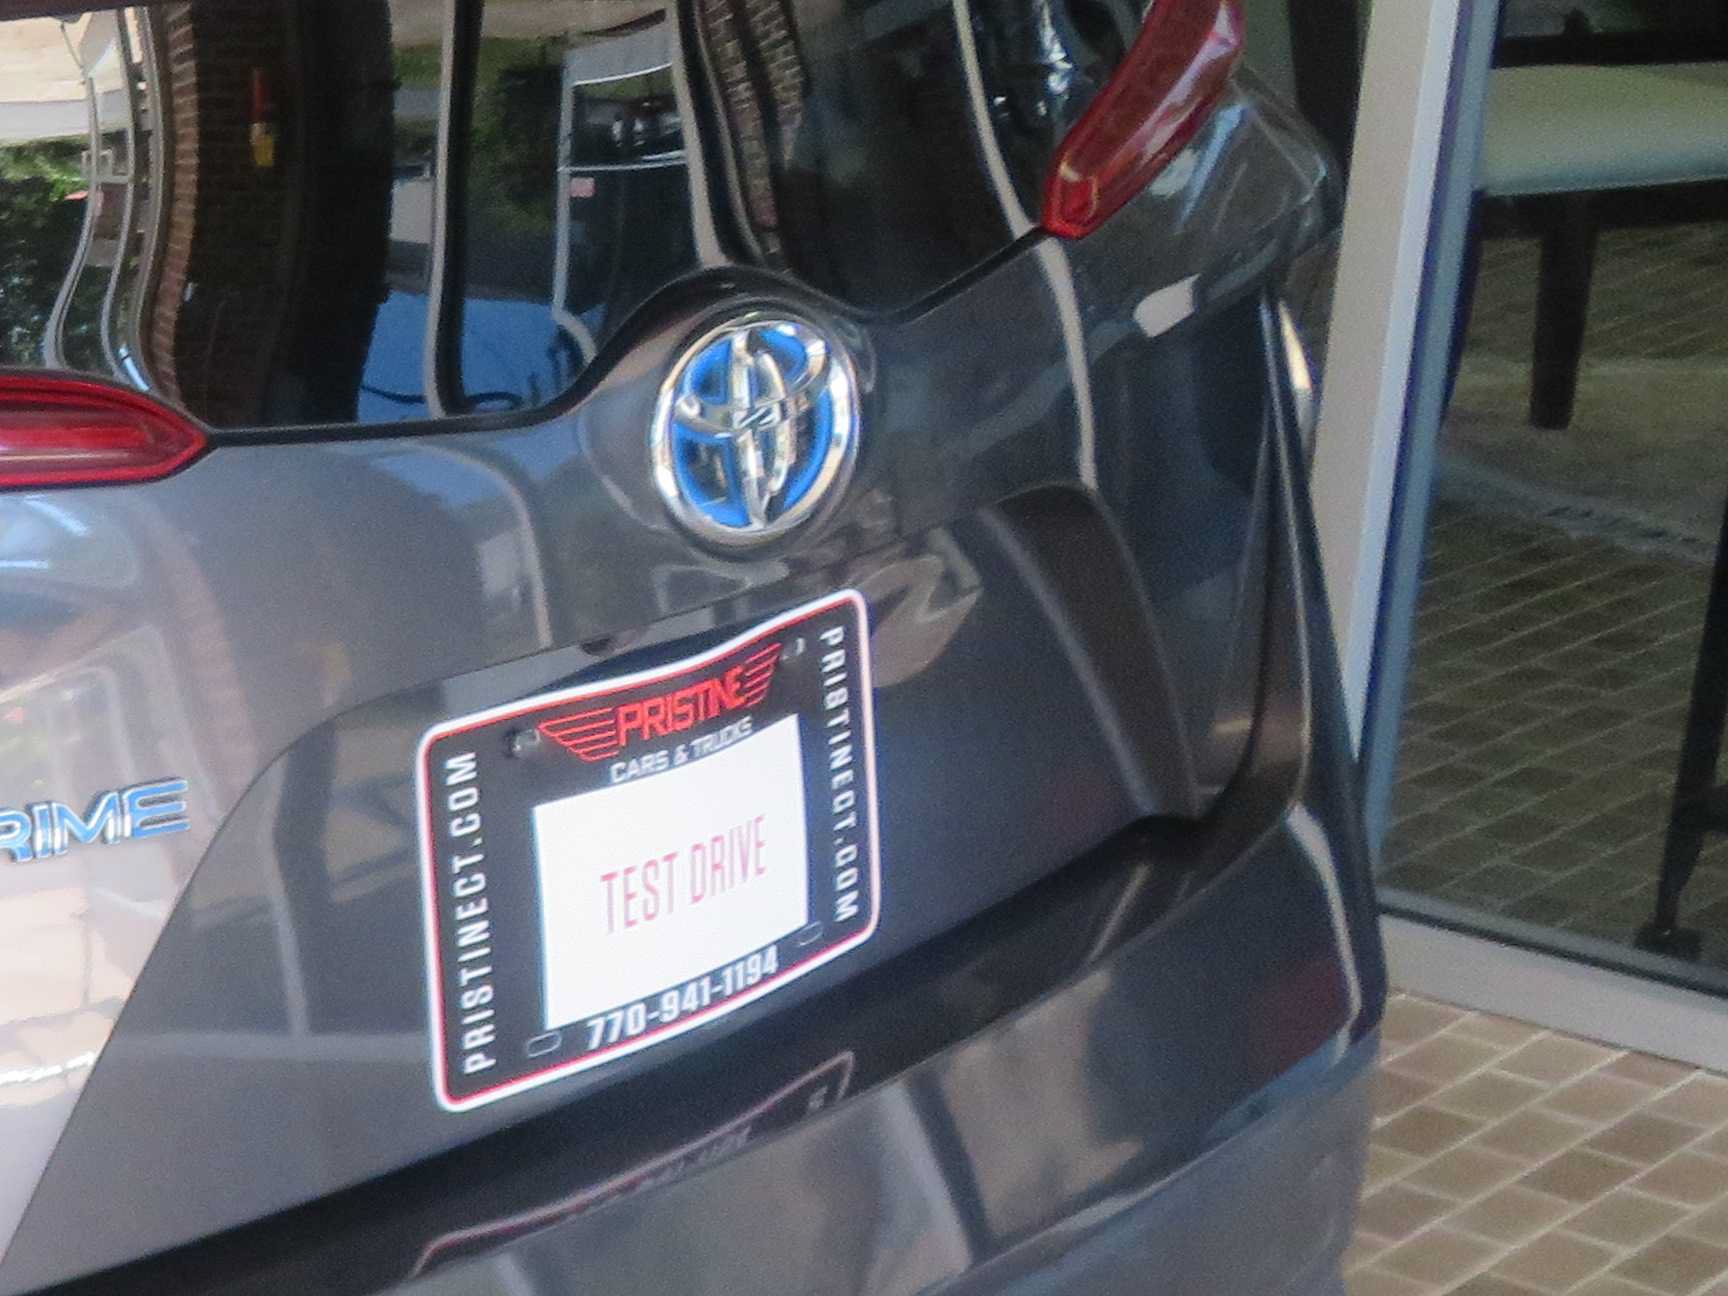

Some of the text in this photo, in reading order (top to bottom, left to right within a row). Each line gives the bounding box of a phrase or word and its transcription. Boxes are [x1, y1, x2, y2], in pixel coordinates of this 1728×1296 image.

[610, 715, 753, 783] CARS & TRUCKS
[617, 665, 747, 747] PRISTINE
[445, 751, 496, 1075] PRISTINECT.COM
[600, 814, 767, 935] TEST DRIVE
[587, 944, 779, 1050] 770-941-1194
